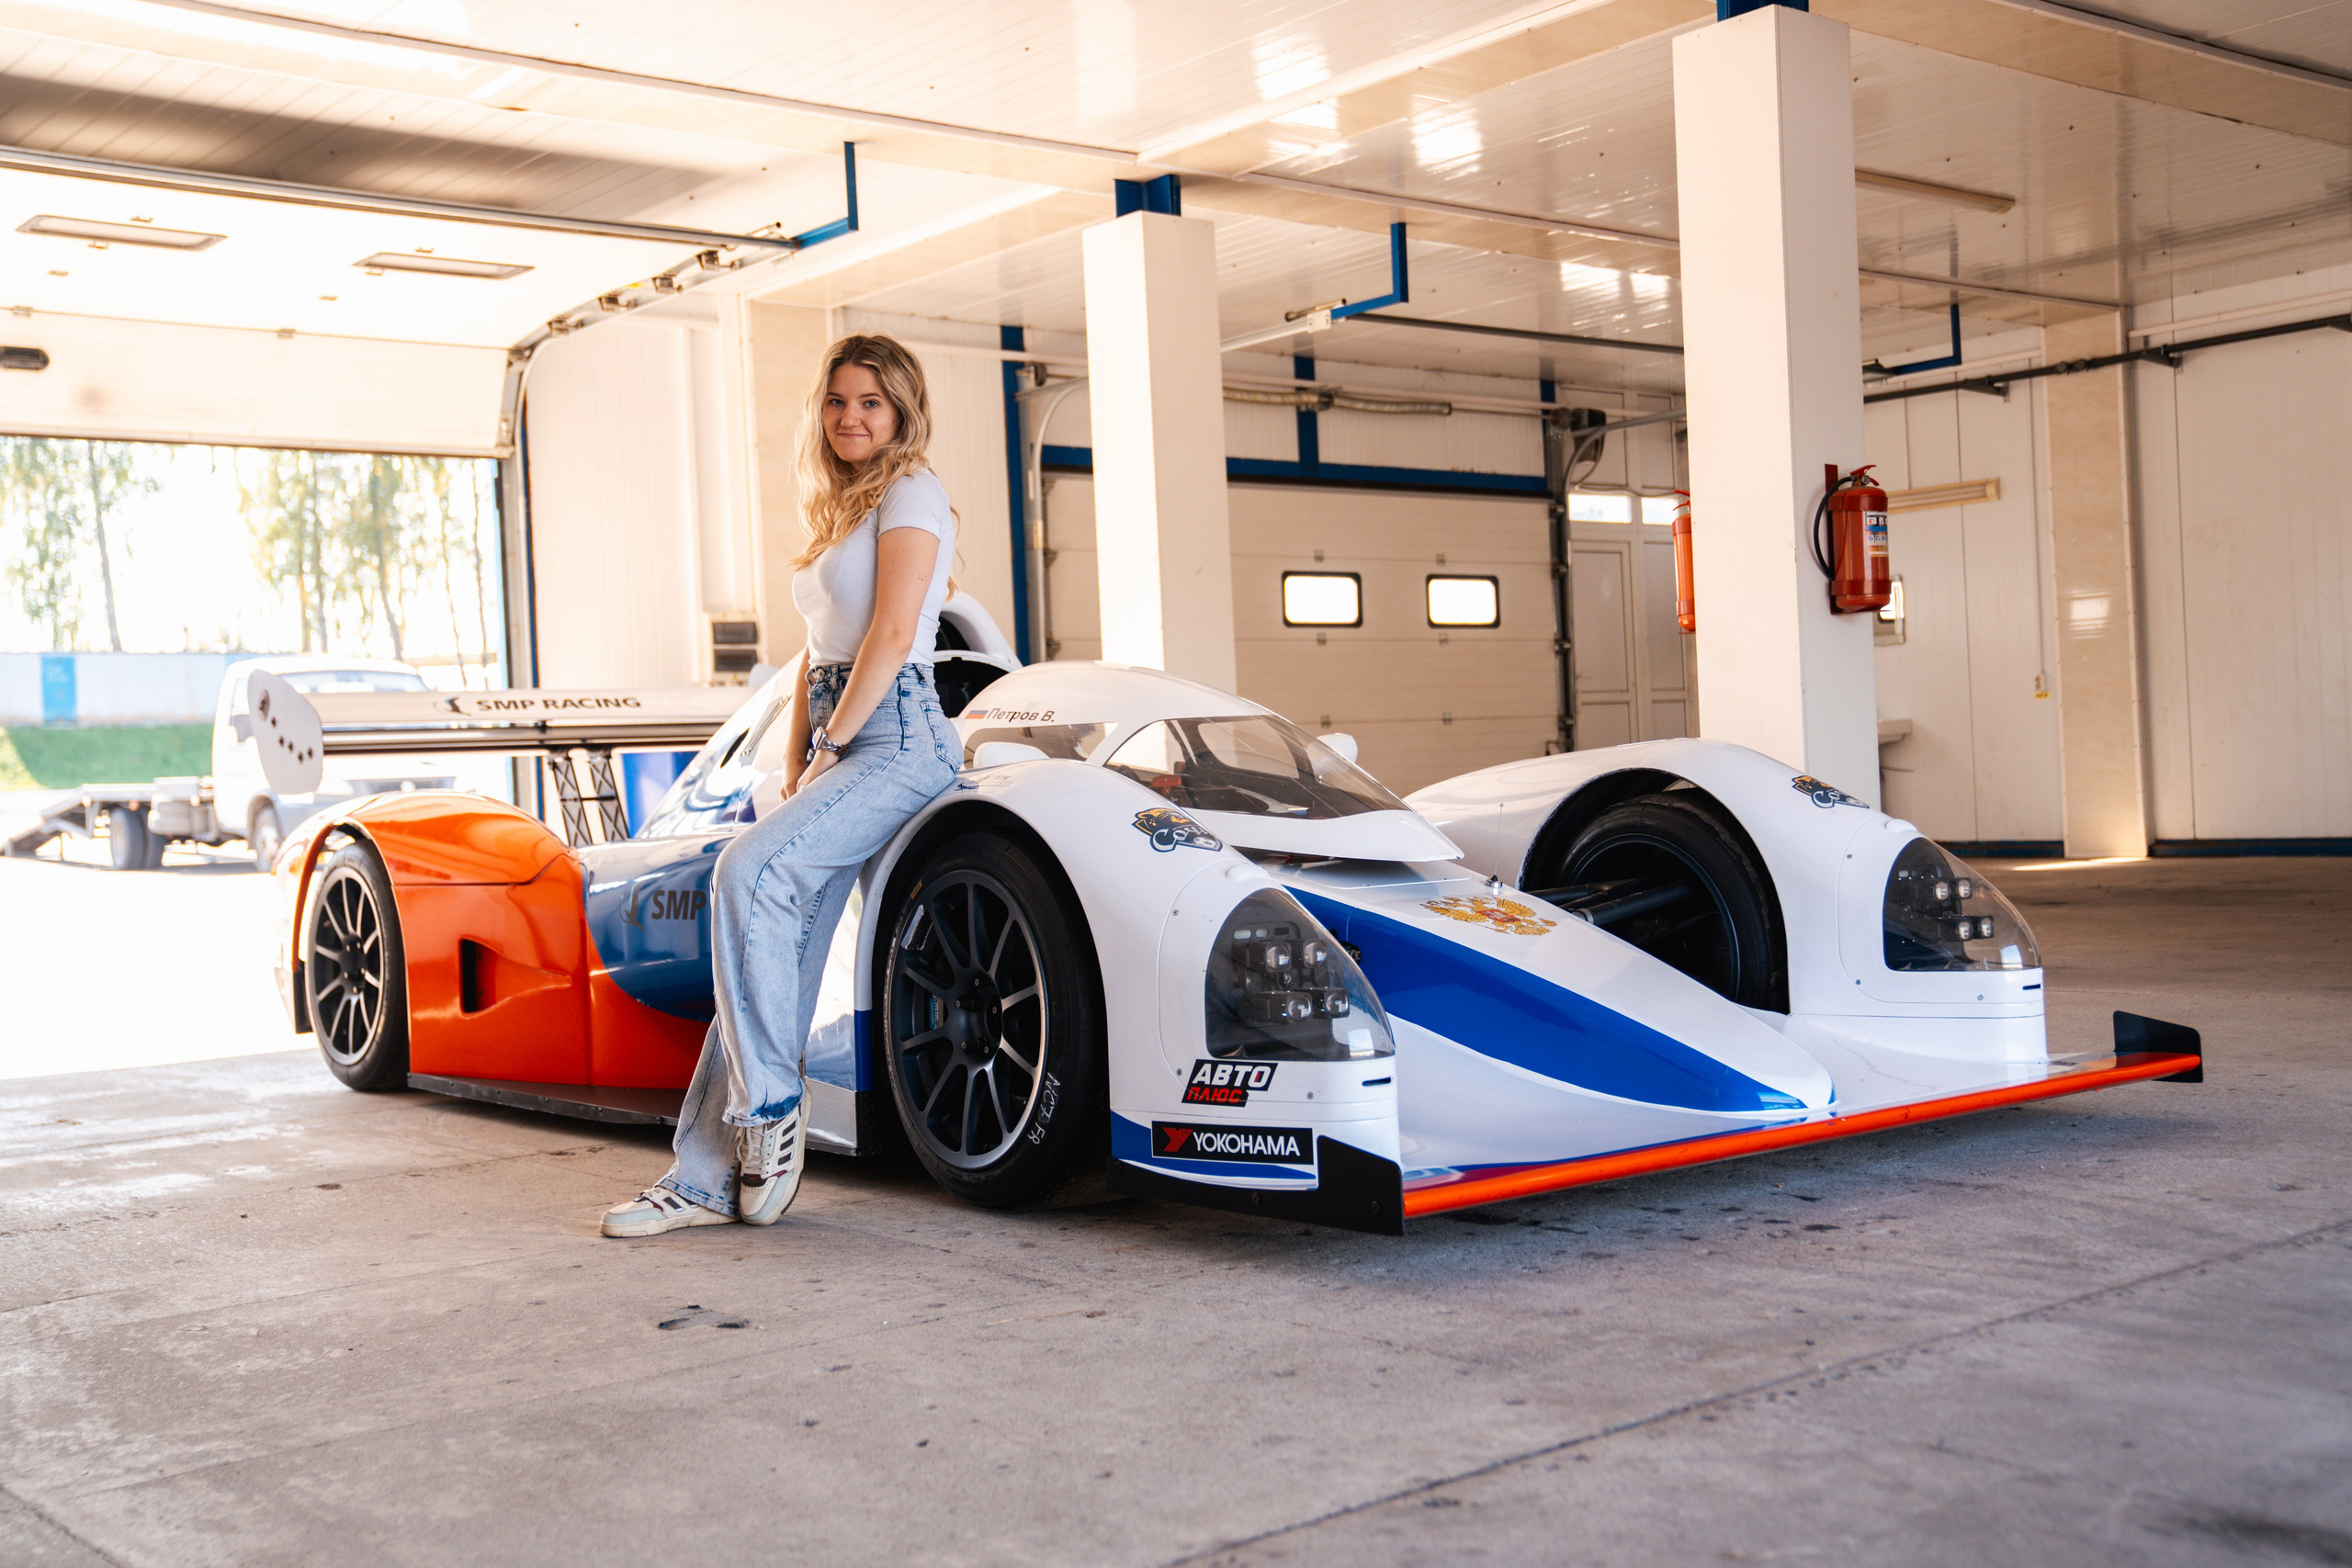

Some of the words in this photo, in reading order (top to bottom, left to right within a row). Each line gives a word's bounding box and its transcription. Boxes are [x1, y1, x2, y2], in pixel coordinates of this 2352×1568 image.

[476, 698, 536, 711] SMP
[542, 696, 642, 709] RACING
[987, 707, 1039, 723] Петров
[1040, 710, 1056, 723] В.
[651, 889, 707, 920] SMP
[1192, 1063, 1272, 1089] АВТО
[1186, 1086, 1242, 1104] ПЛЮС
[1193, 1131, 1301, 1157] YOKOHAMA
